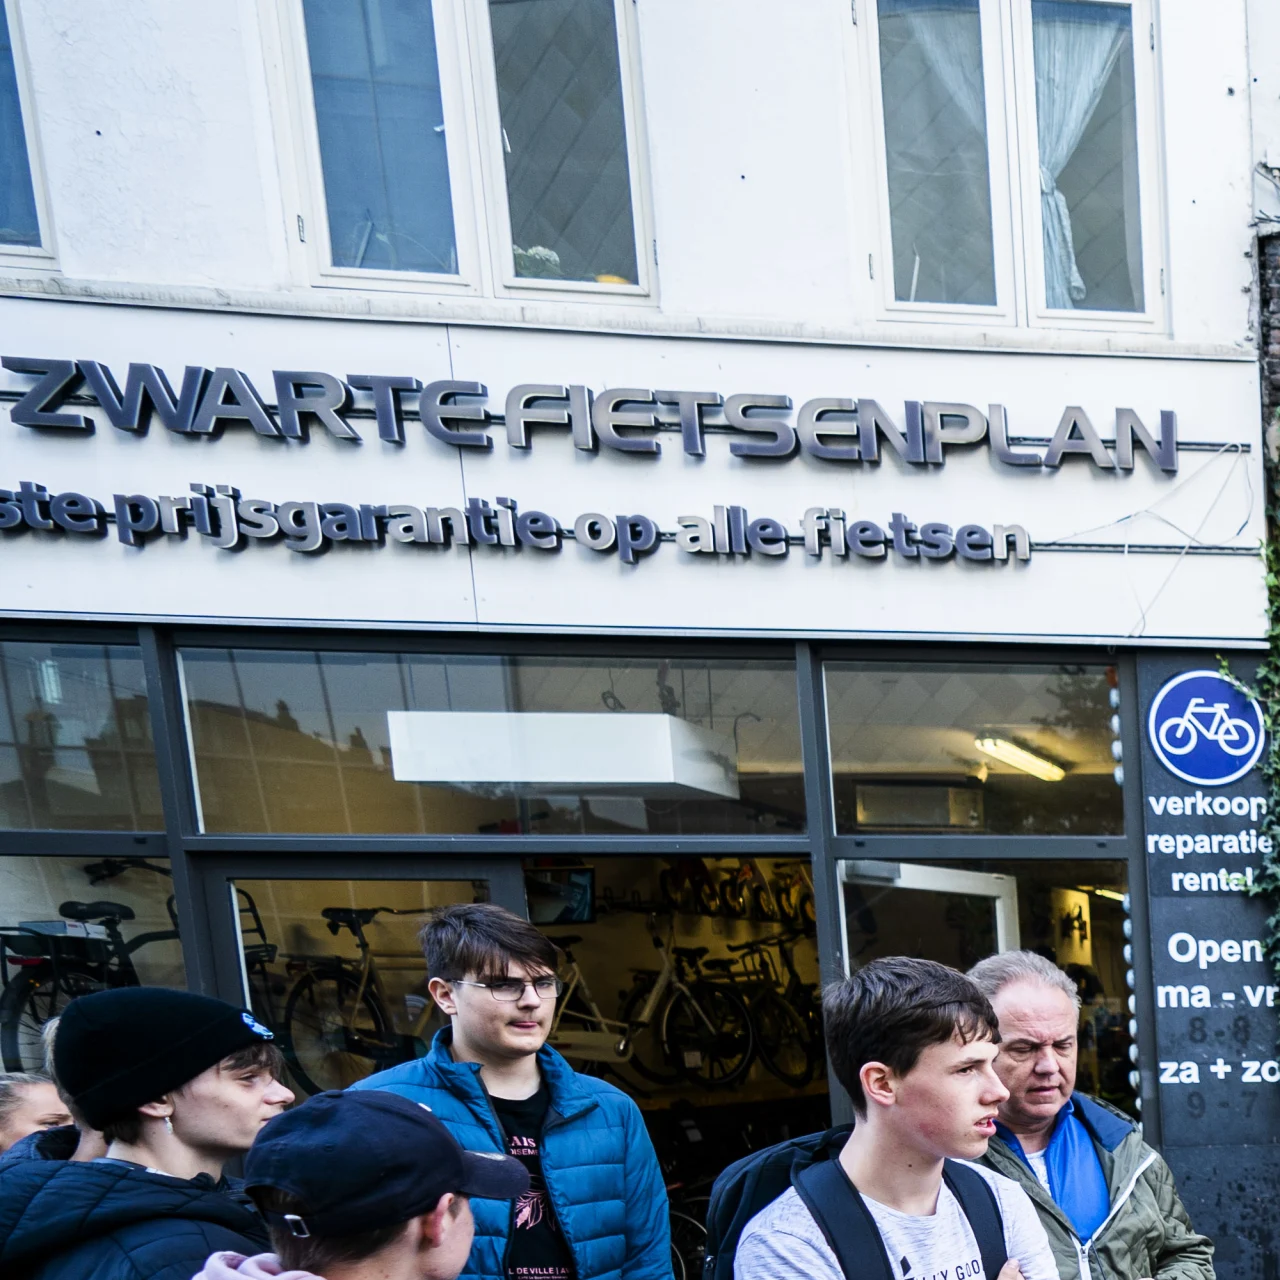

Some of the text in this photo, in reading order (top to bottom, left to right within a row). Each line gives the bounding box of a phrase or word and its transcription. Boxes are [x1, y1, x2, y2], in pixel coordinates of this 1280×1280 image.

[1, 355, 1177, 473] ZWARTE FIETSENPLAN
[113, 483, 559, 552] prijsgarantie
[573, 511, 661, 565] op
[675, 504, 787, 556] alle
[804, 507, 1033, 562] fietsen
[1149, 792, 1268, 821] verkoop
[1147, 831, 1273, 860] reparatie
[1168, 932, 1264, 969] Open
[1157, 984, 1212, 1008] ma
[1243, 984, 1280, 1008] vr
[1159, 1060, 1200, 1084] za
